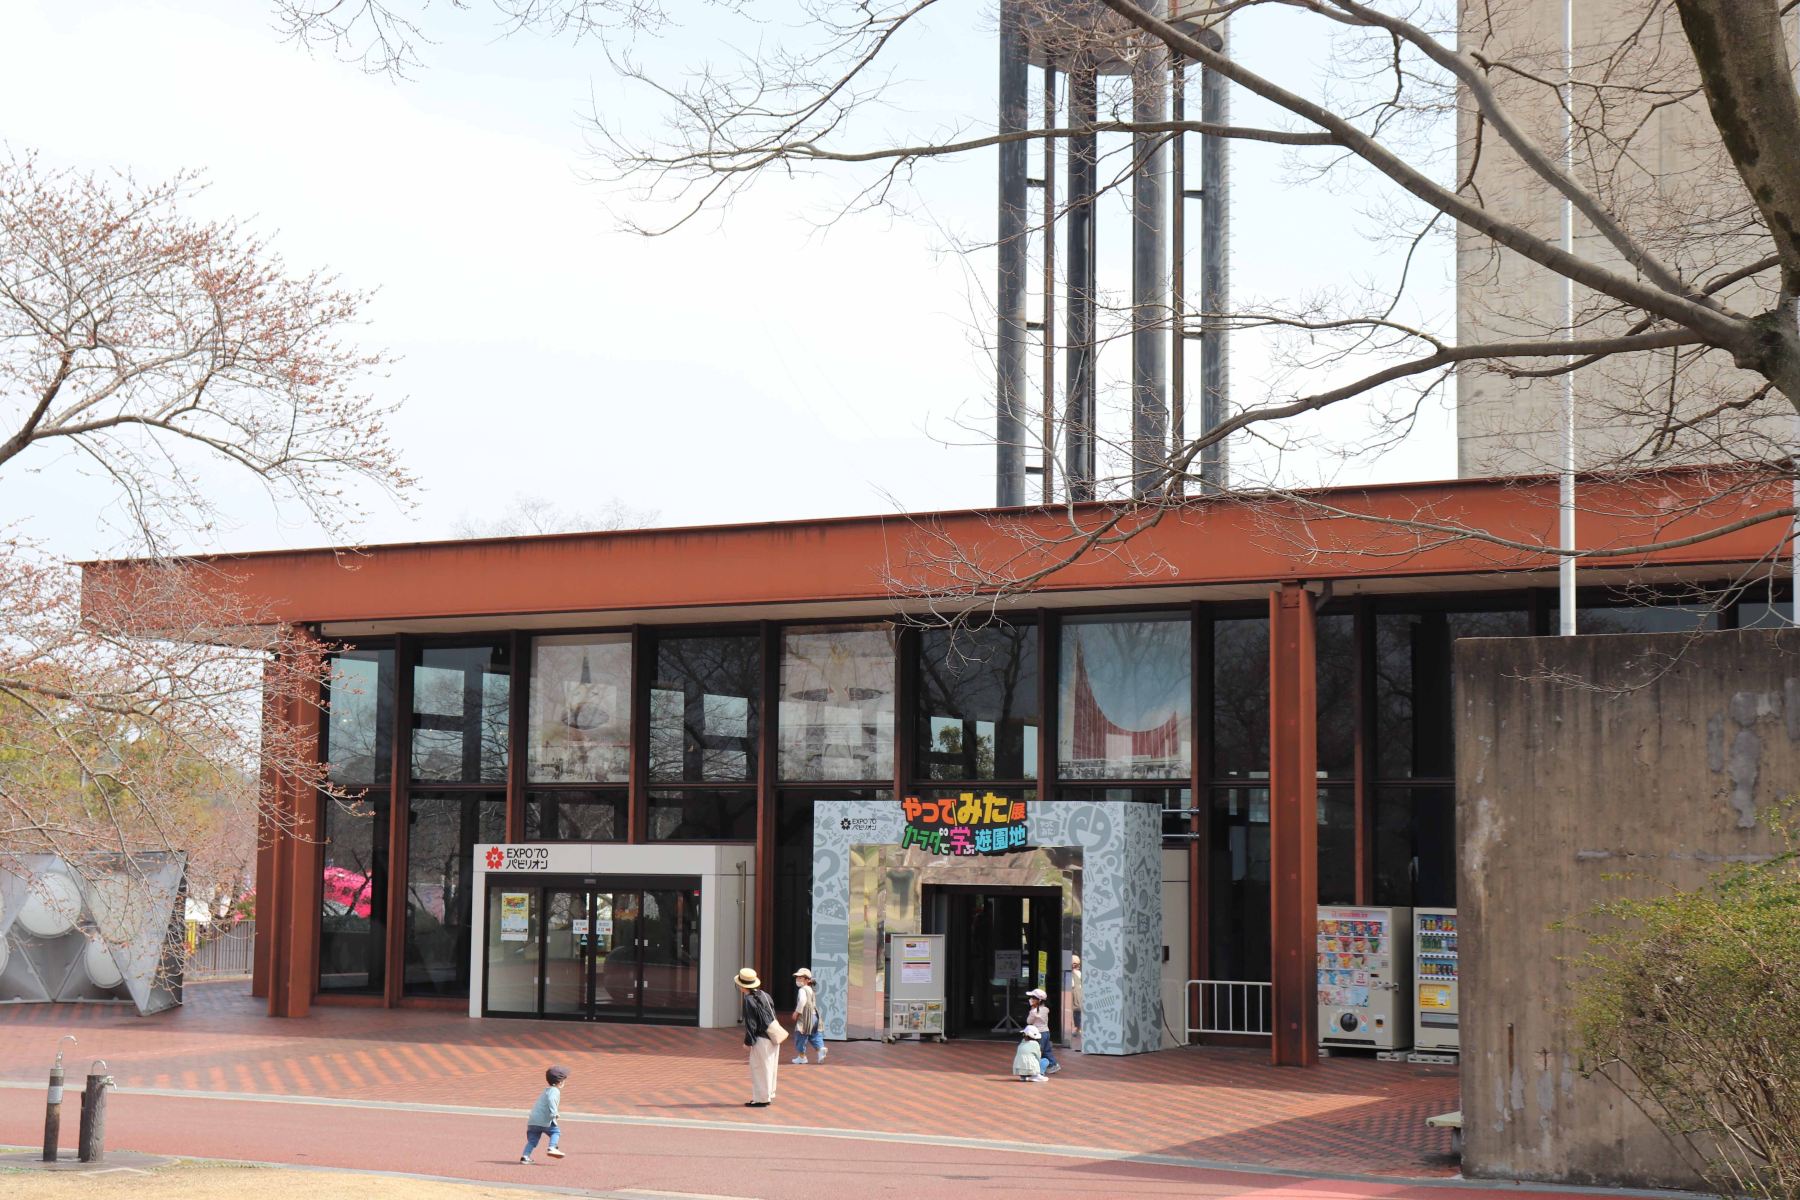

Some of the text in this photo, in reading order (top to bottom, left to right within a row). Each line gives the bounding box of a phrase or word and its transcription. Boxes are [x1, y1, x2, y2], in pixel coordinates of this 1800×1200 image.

[902, 825, 1026, 855] カラダで学ぶ遊園地
[506, 859, 548, 869] パビリオン
